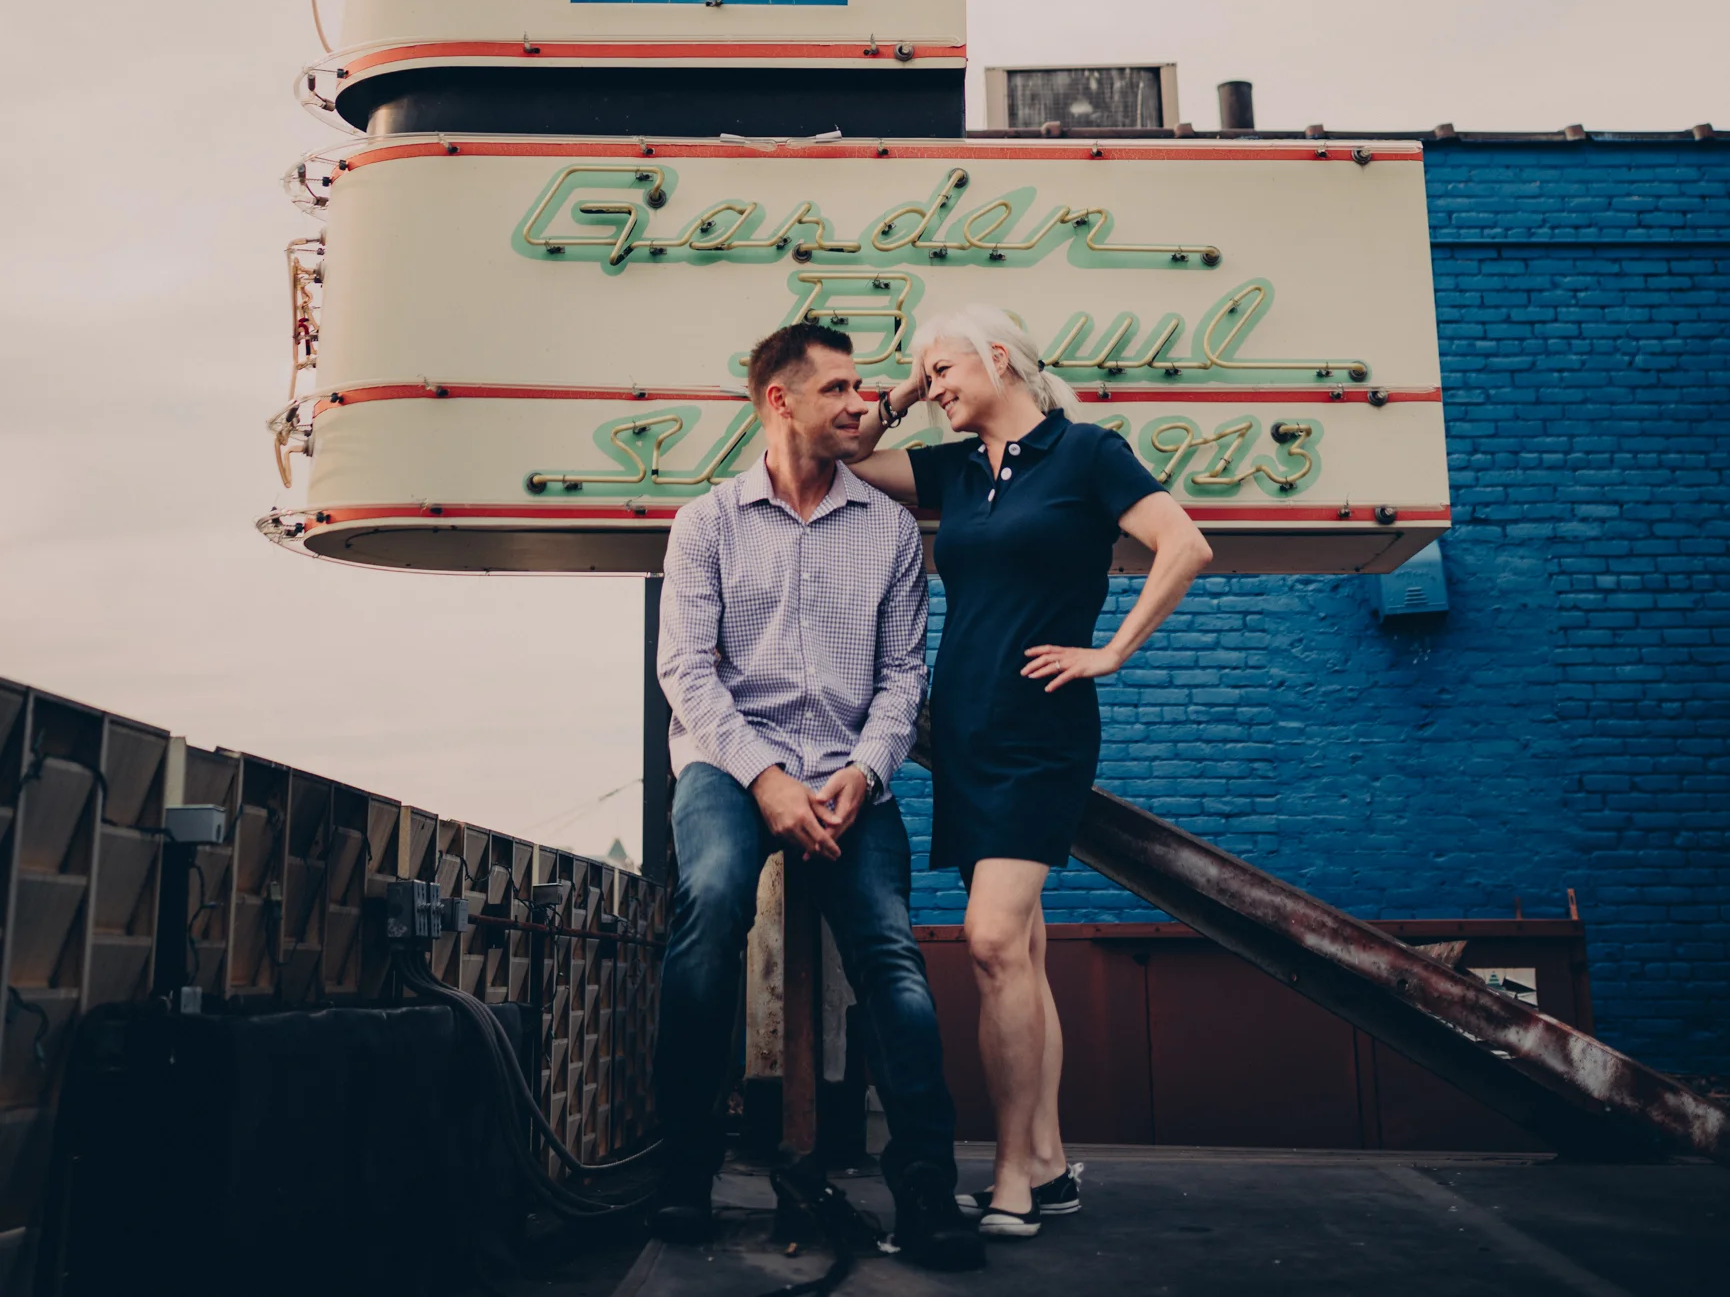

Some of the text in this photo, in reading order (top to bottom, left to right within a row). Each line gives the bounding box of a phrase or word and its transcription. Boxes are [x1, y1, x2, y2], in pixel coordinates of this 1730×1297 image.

[511, 165, 1222, 275] Garden
[728, 270, 1372, 386] Bwl
[1096, 414, 1323, 499] 913
